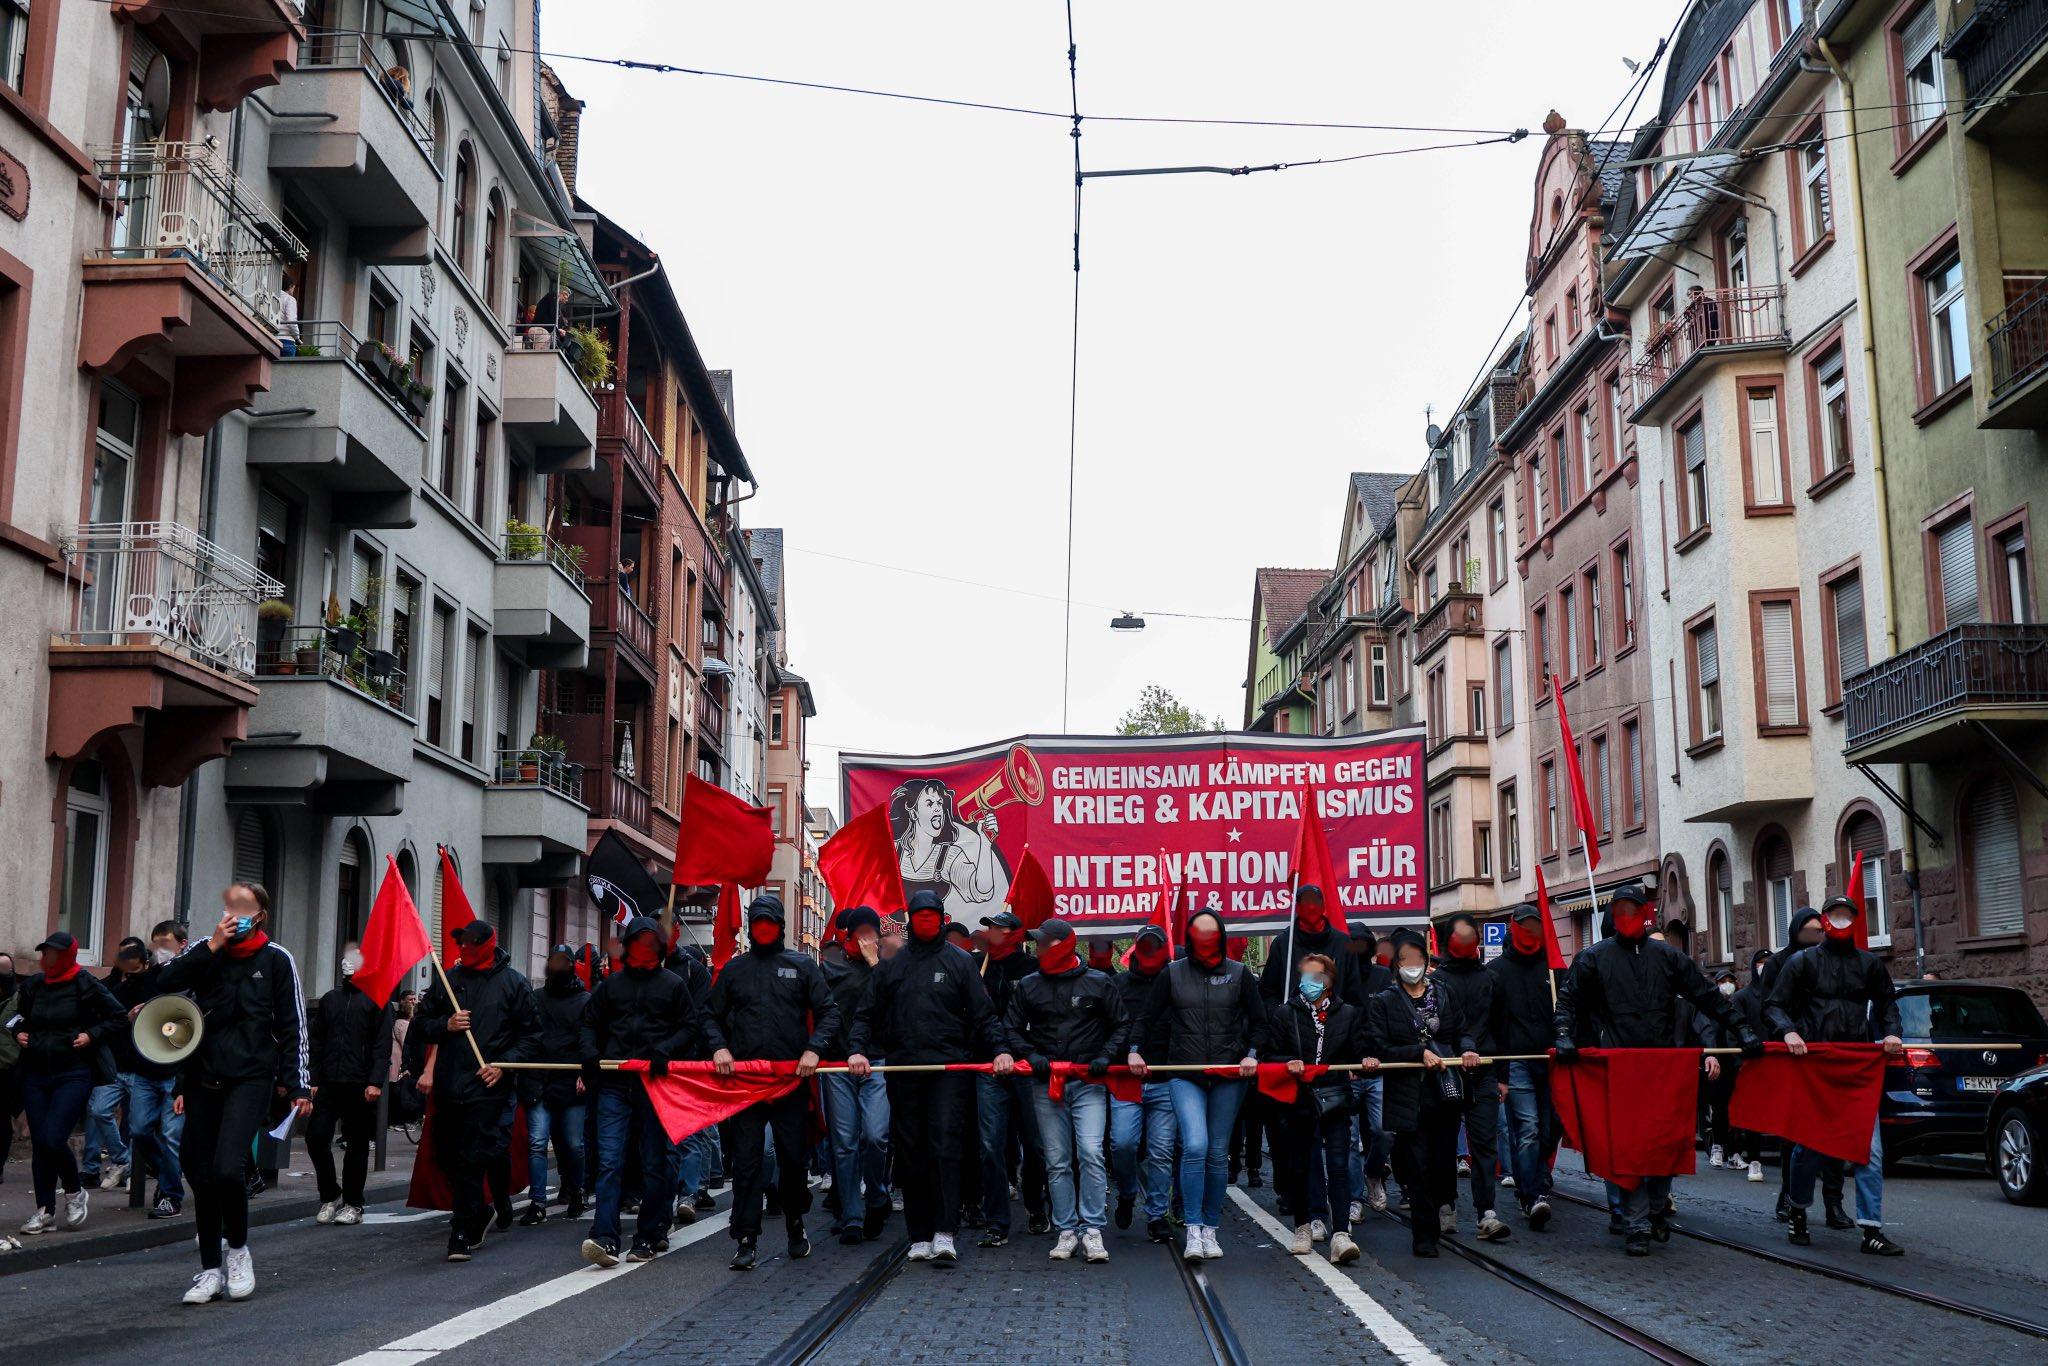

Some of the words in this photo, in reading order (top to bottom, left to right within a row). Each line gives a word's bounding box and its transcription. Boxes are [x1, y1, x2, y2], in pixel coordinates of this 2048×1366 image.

[1052, 764, 1200, 790] GEMEINSAM
[1208, 756, 1326, 786] KÄMPFEN
[1334, 755, 1412, 783] GEGEN
[1053, 794, 1145, 825] KRIEG
[1154, 794, 1179, 823] &
[1189, 784, 1414, 821] KAPITAISMUS
[1053, 851, 1289, 888] INTERNATION
[1348, 838, 1416, 879] FÜR
[1055, 886, 1198, 915] SOLIDARIT
[1206, 890, 1223, 912] &
[1231, 883, 1417, 911] KLASKAMPF
[1487, 926, 1500, 943] P
